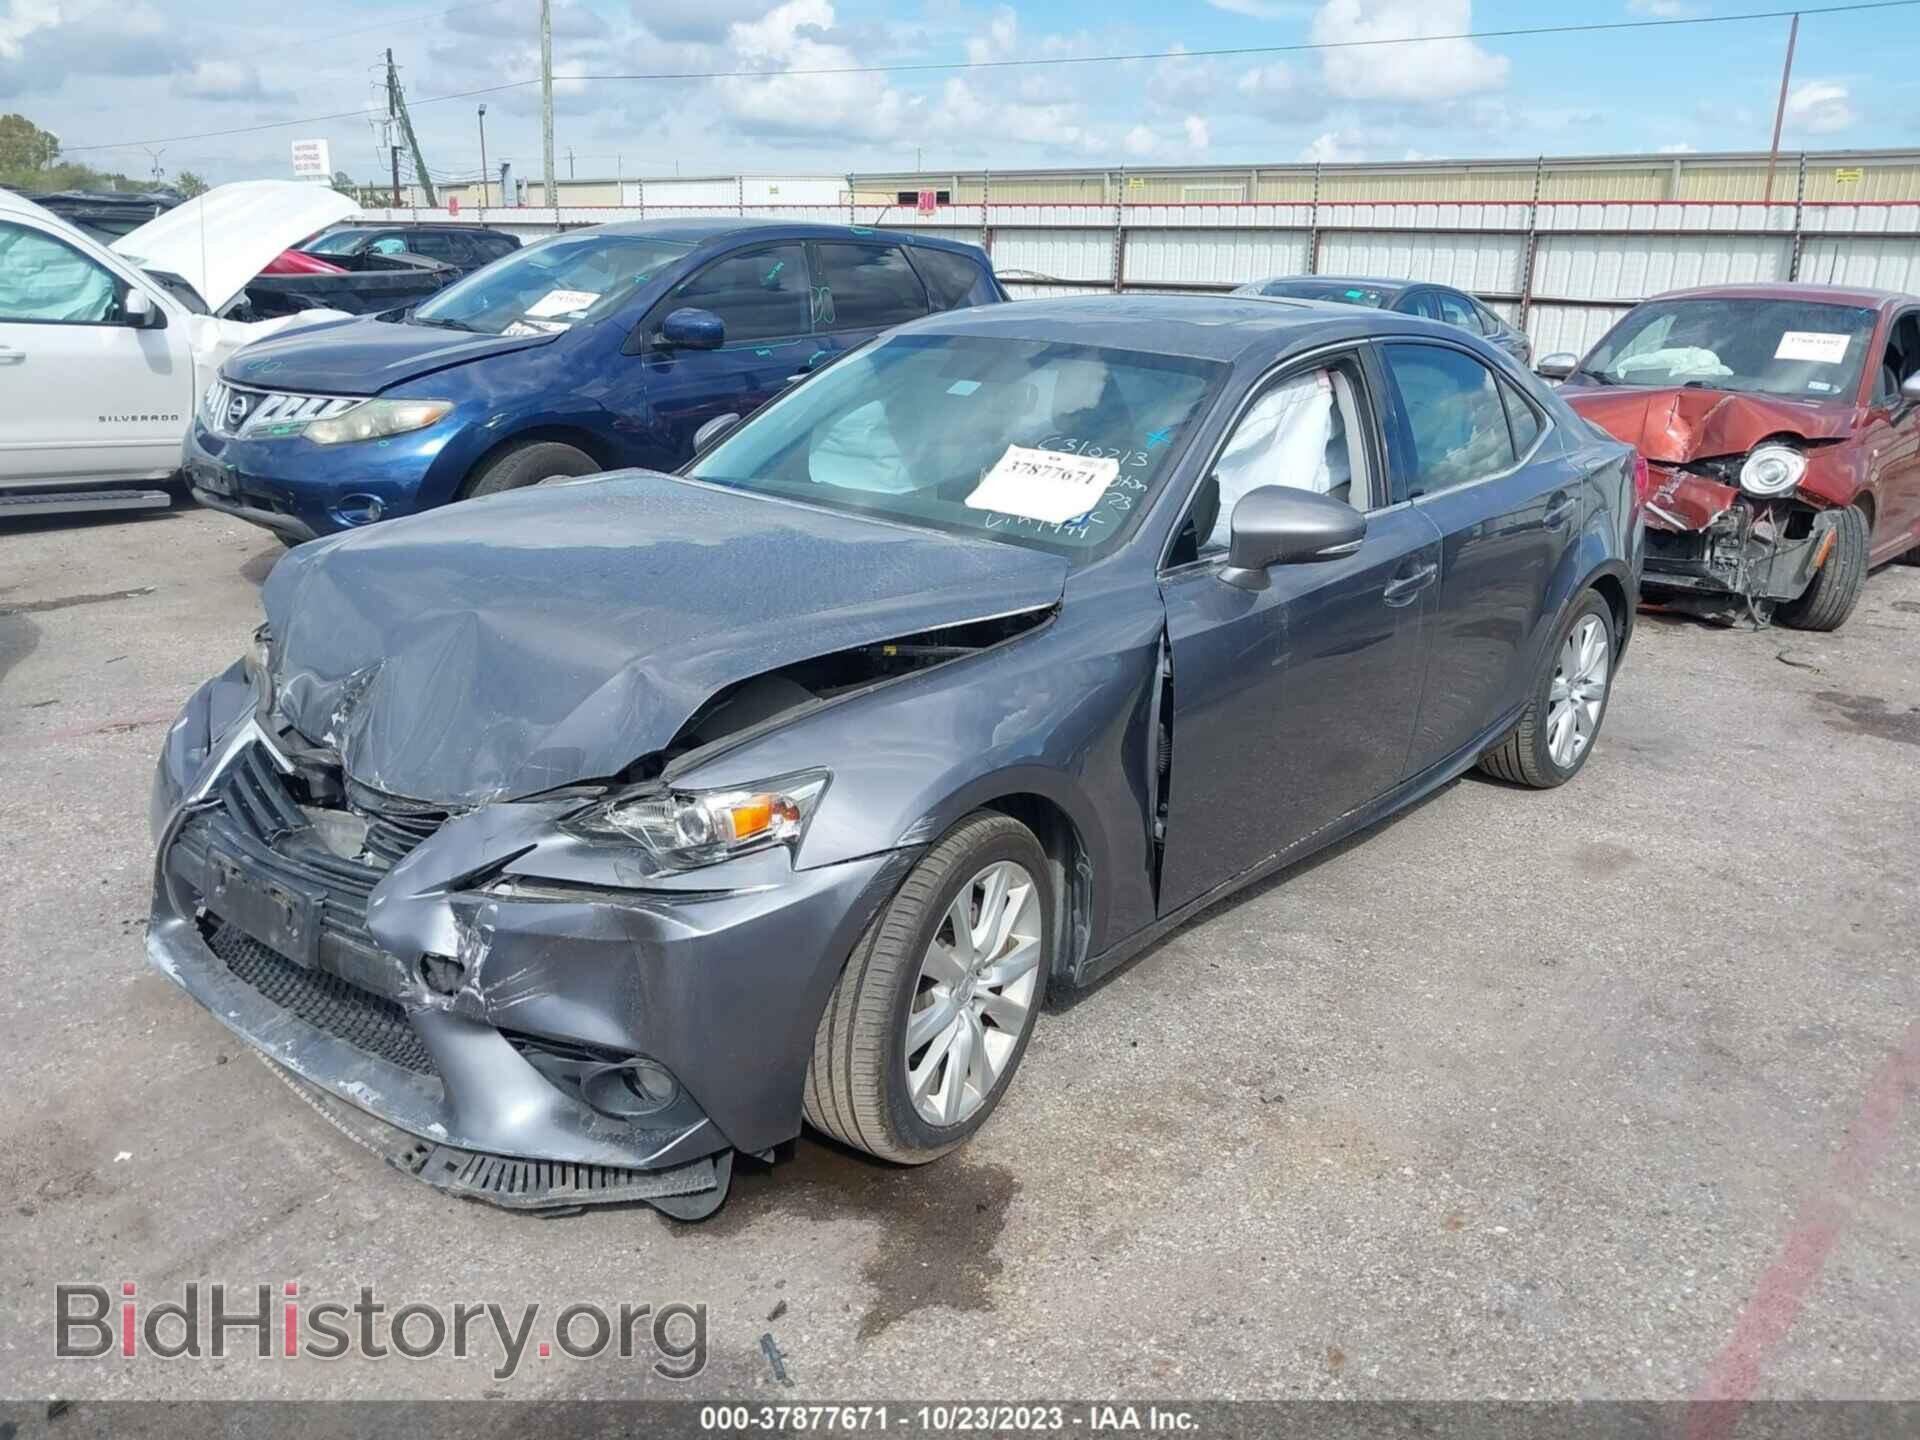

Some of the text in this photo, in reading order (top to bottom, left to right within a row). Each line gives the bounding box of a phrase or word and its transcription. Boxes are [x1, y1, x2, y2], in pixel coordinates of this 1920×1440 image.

[920, 191, 934, 210] 30
[98, 414, 180, 423] SILVERADO
[1005, 460, 1097, 486] 37877671
